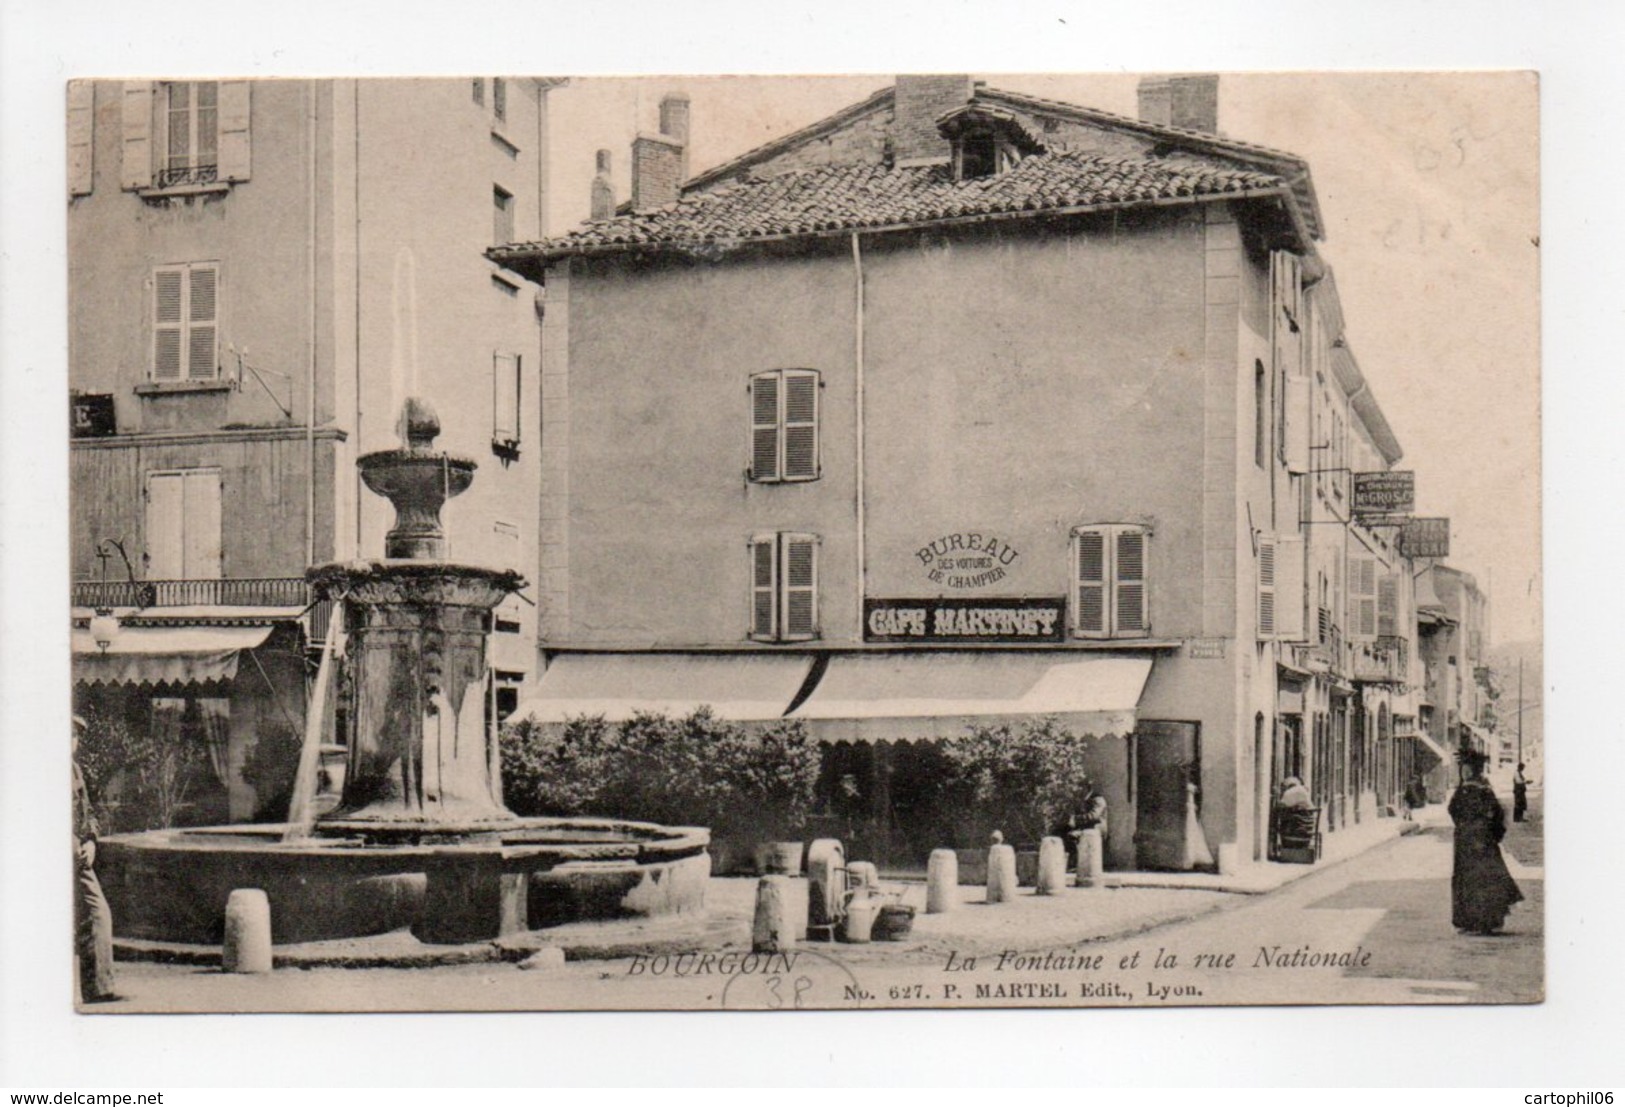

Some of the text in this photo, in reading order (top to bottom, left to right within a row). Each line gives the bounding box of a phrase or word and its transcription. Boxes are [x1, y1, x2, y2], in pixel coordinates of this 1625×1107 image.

[915, 533, 1019, 566] BUREAU
[937, 557, 993, 570] DES VOITURES
[927, 566, 1007, 589] DE CHAMPIER
[934, 608, 1057, 634] MARTINET
